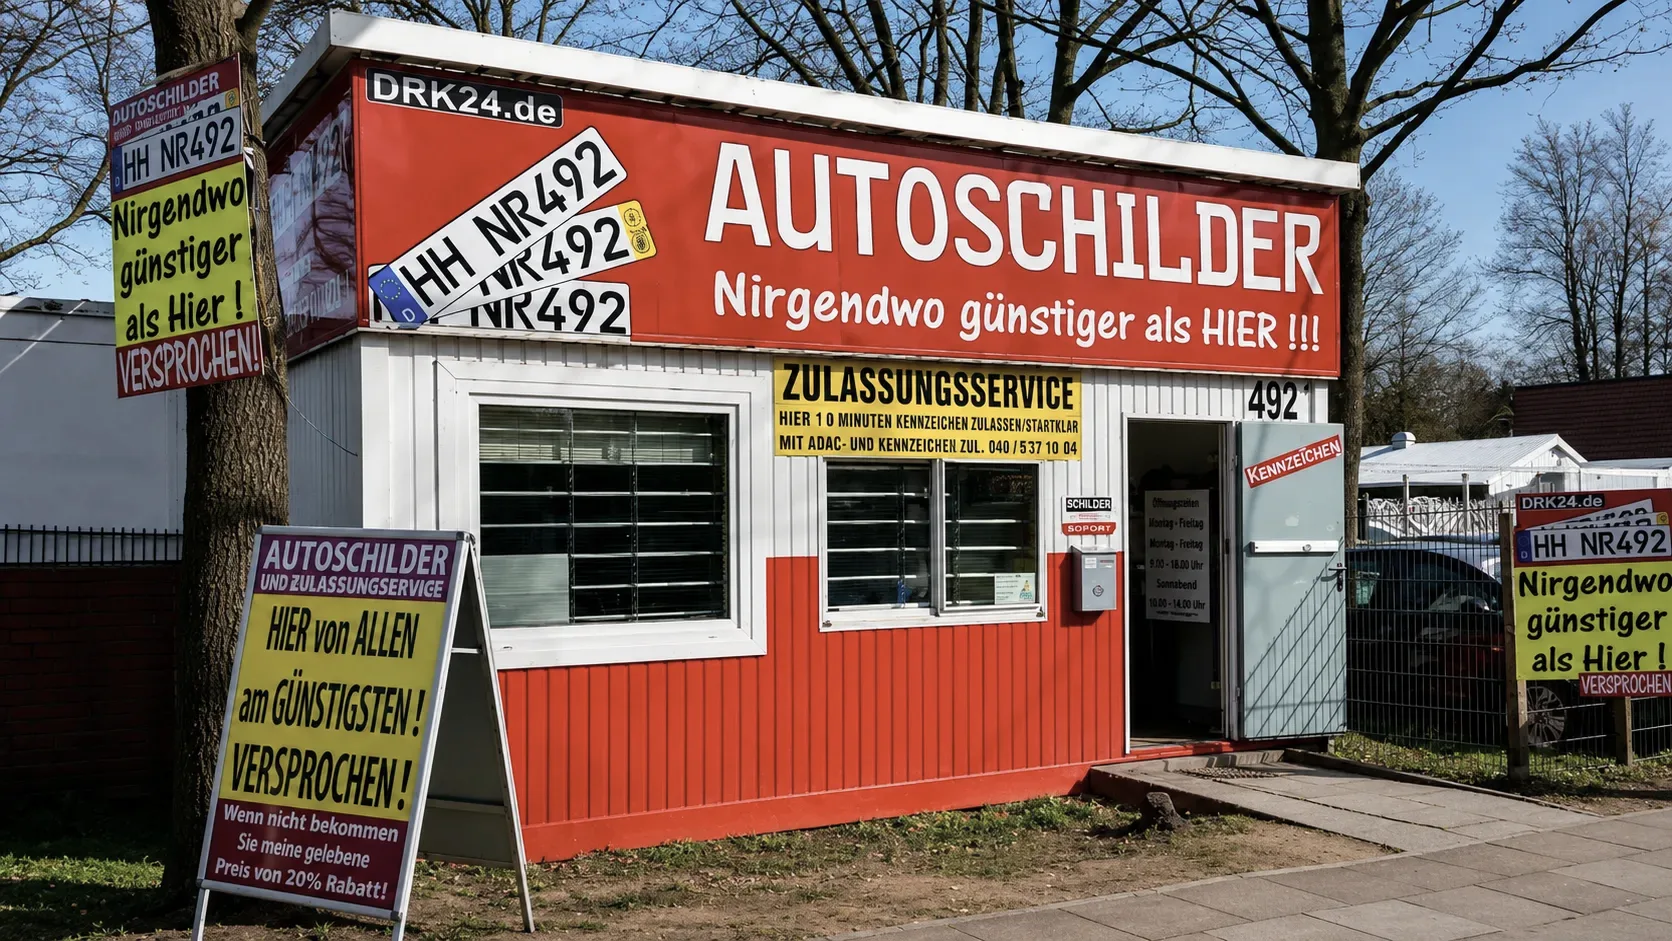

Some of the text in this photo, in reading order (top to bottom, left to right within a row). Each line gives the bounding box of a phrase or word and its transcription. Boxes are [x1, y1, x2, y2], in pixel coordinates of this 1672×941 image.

[374, 73, 556, 124] DRK24.de
[124, 144, 149, 184] HH
[161, 116, 234, 172] NR492
[114, 177, 244, 240] Nirgendwo
[400, 236, 476, 307] HH
[472, 140, 617, 257] NR492
[704, 142, 1323, 295] AUTOSCHILDER
[120, 233, 242, 298] günstiger
[126, 303, 159, 341] als
[168, 292, 224, 332] Hier
[402, 308, 416, 322] D
[713, 270, 1320, 352] Nirgendwo günstiger als HIER !!!
[119, 325, 259, 393] VERSPROCHEN!
[783, 363, 1074, 410] ZULASSUNGSSERVICE
[1248, 380, 1298, 420] 492
[779, 411, 811, 427] HIER
[838, 413, 892, 429] MINUTEN
[896, 415, 968, 431] KENNZEICHEN
[971, 417, 1079, 433] ZULASSEN/STARTKLAR
[779, 435, 804, 450] MIT
[808, 436, 847, 451] ADAC-
[850, 437, 874, 452] UND
[878, 437, 956, 453] KENNZEICHEN
[960, 440, 985, 454] ZUL.
[989, 440, 1010, 454] 040
[1046, 441, 1059, 455] 10
[1063, 441, 1077, 455] 04
[1246, 440, 1341, 484] KENNZEICHEN
[1067, 499, 1111, 509] SCHILDER
[1521, 495, 1603, 509] DRK24.de
[1067, 525, 1112, 533] SOPORT
[1179, 518, 1204, 531] Freitag
[263, 540, 449, 576] AUTOSCHILDER
[1149, 539, 1174, 551] Montag
[1179, 539, 1204, 552] Freitag
[1534, 530, 1666, 557] HH NR492
[1191, 560, 1204, 570] Uhr
[260, 574, 444, 598] UND ZULASSUNGSERVICE
[1156, 579, 1197, 590] Sonnabend
[1519, 568, 1672, 601] Nirgendwo
[1193, 599, 1206, 610] Uhr
[266, 605, 420, 659] HIER von ALLEN
[1527, 606, 1667, 640] günstiger
[1532, 646, 1573, 672] als
[1583, 644, 1647, 672] Hier
[1581, 674, 1672, 694] VERSPROCHEN
[238, 687, 269, 724] am
[272, 669, 413, 736] GÜNSTIGSTEN
[231, 742, 398, 809] VERSPROCHEN
[224, 804, 398, 843] Wenn nicht bekommen
[237, 833, 370, 869] Sie meine gelebene
[215, 858, 388, 900] Preis von 20% Rabatt!
